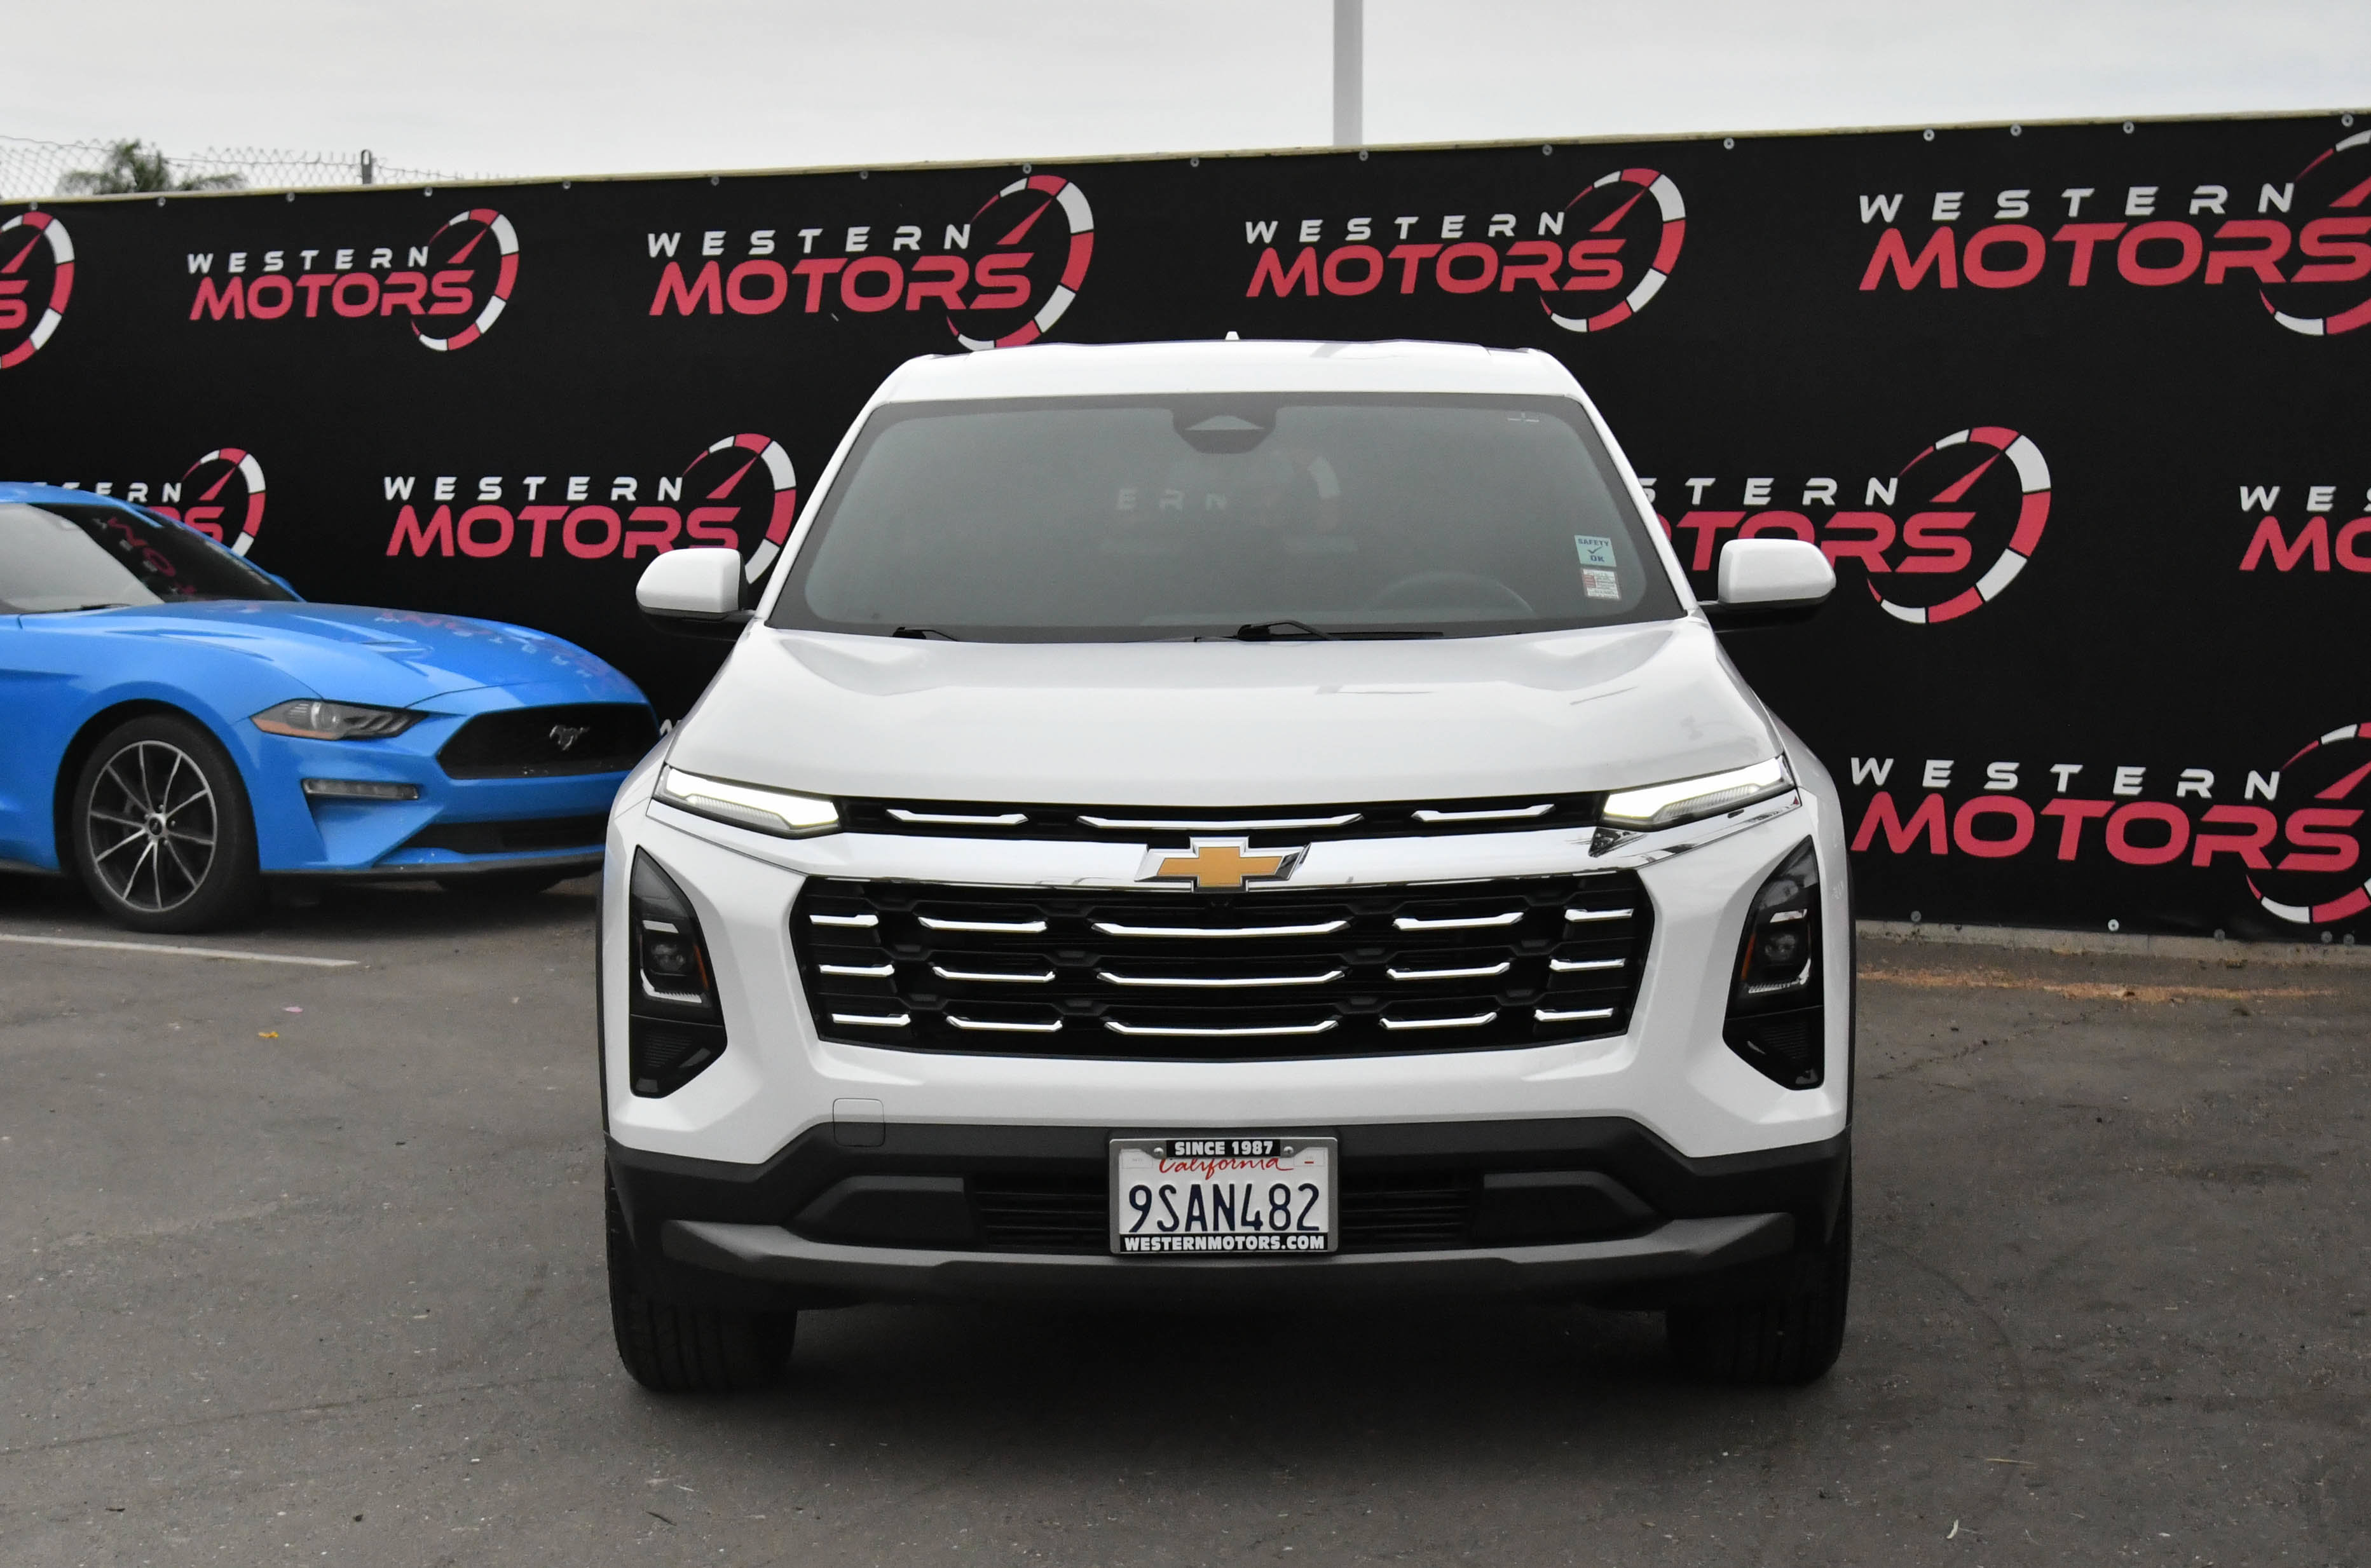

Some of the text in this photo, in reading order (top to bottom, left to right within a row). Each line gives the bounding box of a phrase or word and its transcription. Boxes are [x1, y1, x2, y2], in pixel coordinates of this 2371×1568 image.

[1860, 183, 2293, 224] WESTERN
[648, 224, 971, 258] WESTERN
[1245, 212, 1564, 244] WESTERN
[188, 246, 428, 274] WESTERN
[1246, 239, 1626, 297] MOTORS
[1860, 217, 2371, 290] MOTORS
[189, 270, 474, 321] MOTORS
[650, 253, 1034, 316] MOTORS
[384, 477, 683, 501] WESTERN
[386, 505, 741, 559] MOTORS
[1578, 538, 1609, 547] SAFETY
[1590, 554, 1604, 562] OK
[1850, 757, 2281, 800] WESTERN
[1850, 791, 2364, 871] MOTORS
[1175, 1141, 1274, 1156] SINCE 1987
[1128, 1183, 1320, 1233] 9SAN482
[1124, 1236, 1325, 1251] WESTERNMOTORS.COM
